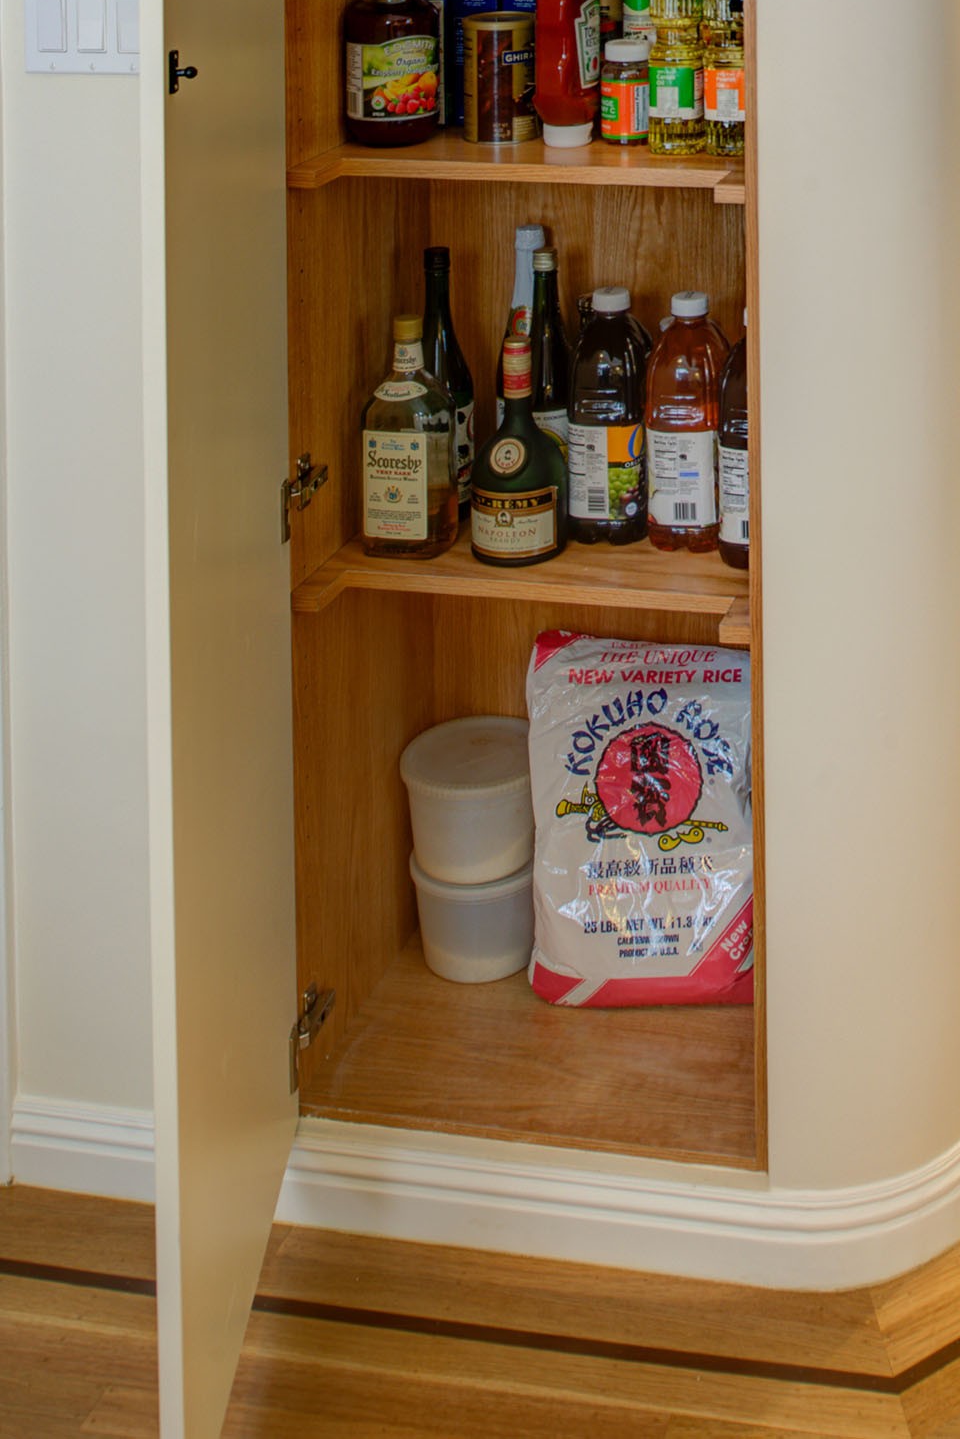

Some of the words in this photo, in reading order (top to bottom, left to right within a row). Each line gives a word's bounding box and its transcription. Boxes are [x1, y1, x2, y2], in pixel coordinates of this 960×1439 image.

[367, 449, 422, 473] Scoresby
[478, 527, 537, 538] NAPOLEON
[643, 650, 716, 667] UNIQUE
[568, 668, 615, 685] NEW
[620, 669, 696, 684] VARIETY
[703, 669, 742, 683] RICE
[564, 688, 668, 775] KOKUHO
[654, 879, 710, 894] QUALITY
[720, 920, 747, 952] New
